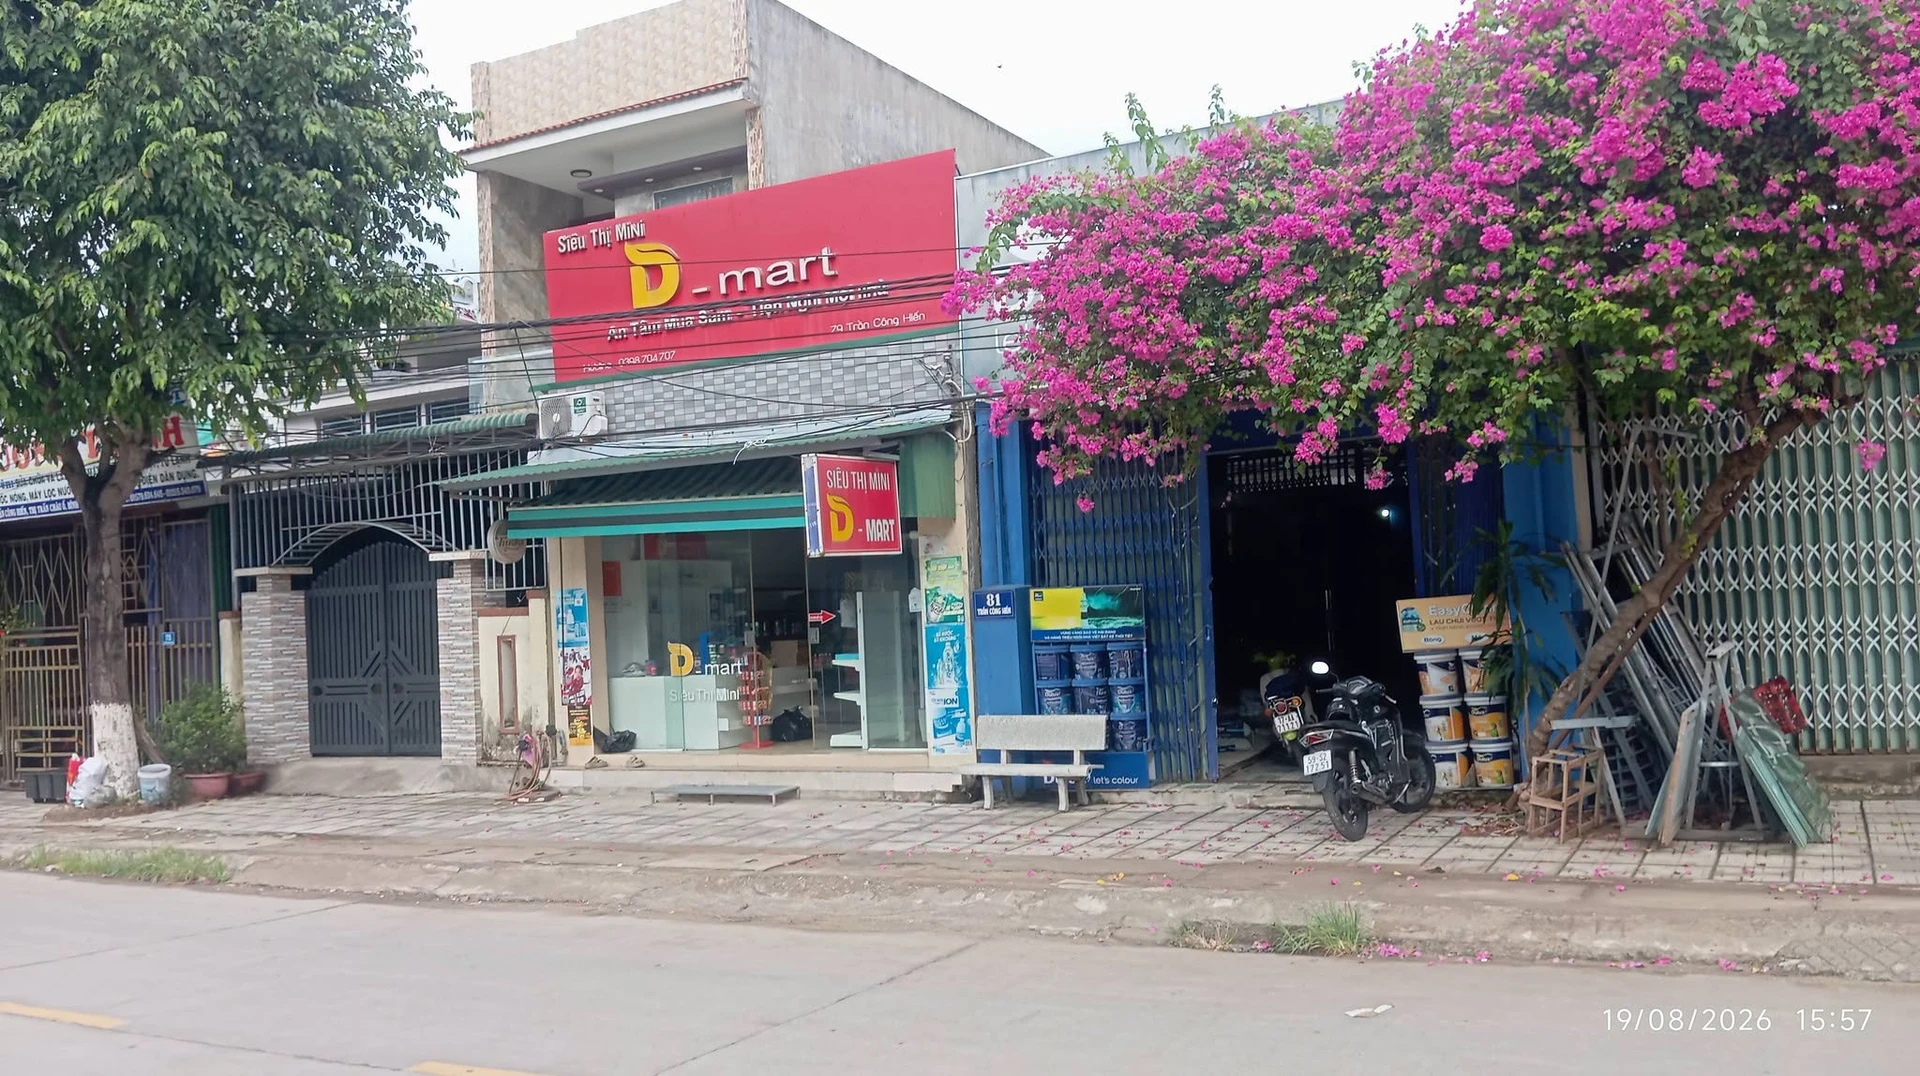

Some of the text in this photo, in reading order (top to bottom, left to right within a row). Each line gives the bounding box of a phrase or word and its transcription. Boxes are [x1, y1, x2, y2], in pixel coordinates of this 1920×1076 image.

[590, 227, 611, 248] Thị
[719, 246, 838, 295] mart
[830, 325, 844, 333] 79
[873, 316, 899, 328] Công
[903, 310, 926, 322] Hiến
[826, 466, 849, 489] SIÊU
[851, 471, 867, 494] THỊ
[865, 518, 895, 542] MART
[986, 593, 1001, 607] 81
[705, 660, 743, 676] mart
[1111, 776, 1139, 784] colour
